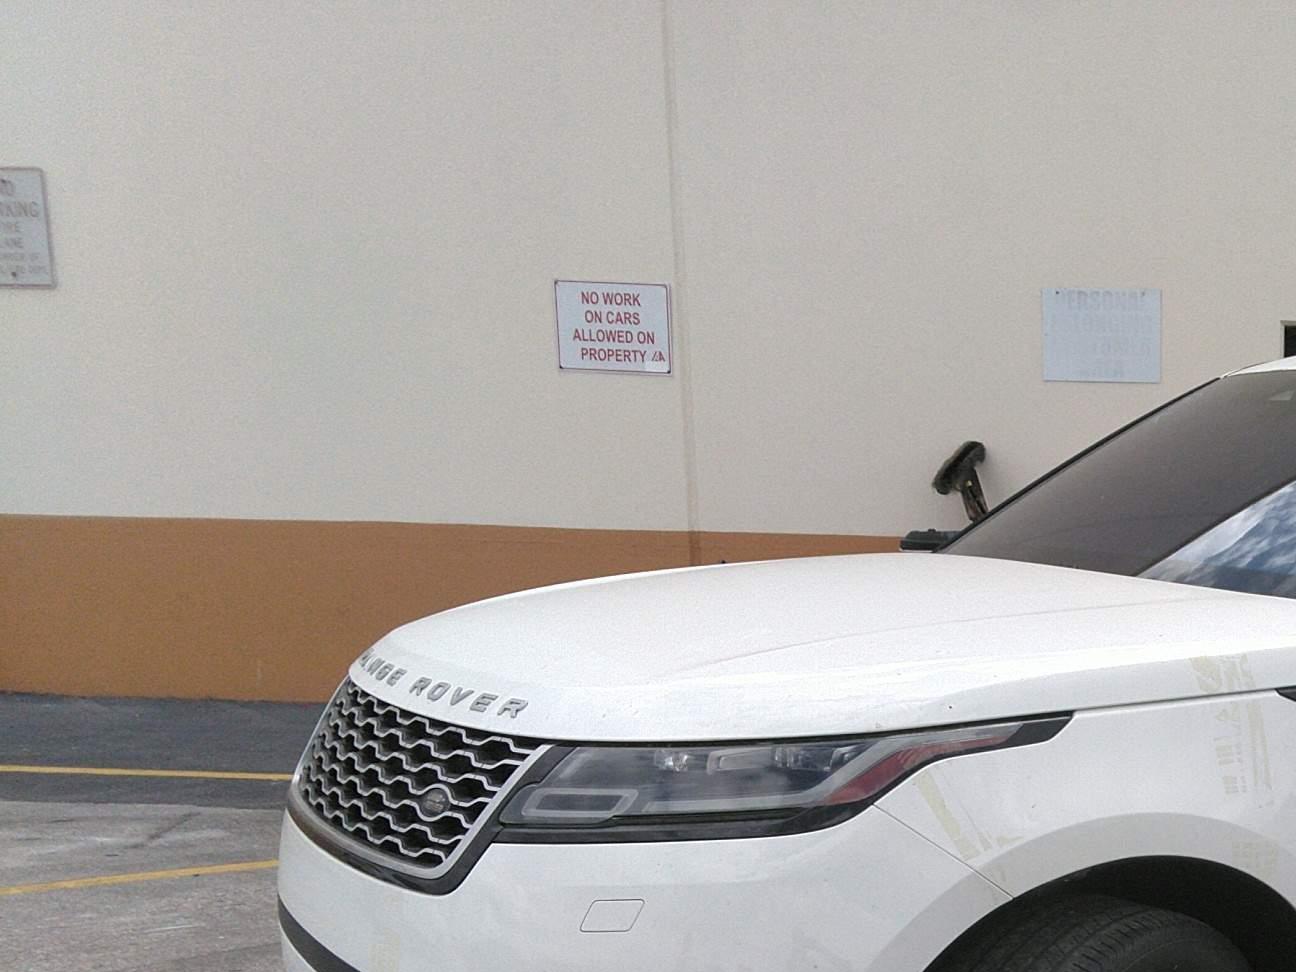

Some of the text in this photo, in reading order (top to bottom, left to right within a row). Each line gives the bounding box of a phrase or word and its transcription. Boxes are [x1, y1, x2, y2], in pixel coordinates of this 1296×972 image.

[581, 291, 641, 307] NO WORK
[584, 310, 641, 326] ON CARS
[572, 328, 655, 345] ALLOWED ON
[581, 347, 648, 363] PROPERTY
[409, 676, 529, 719] ROVER
